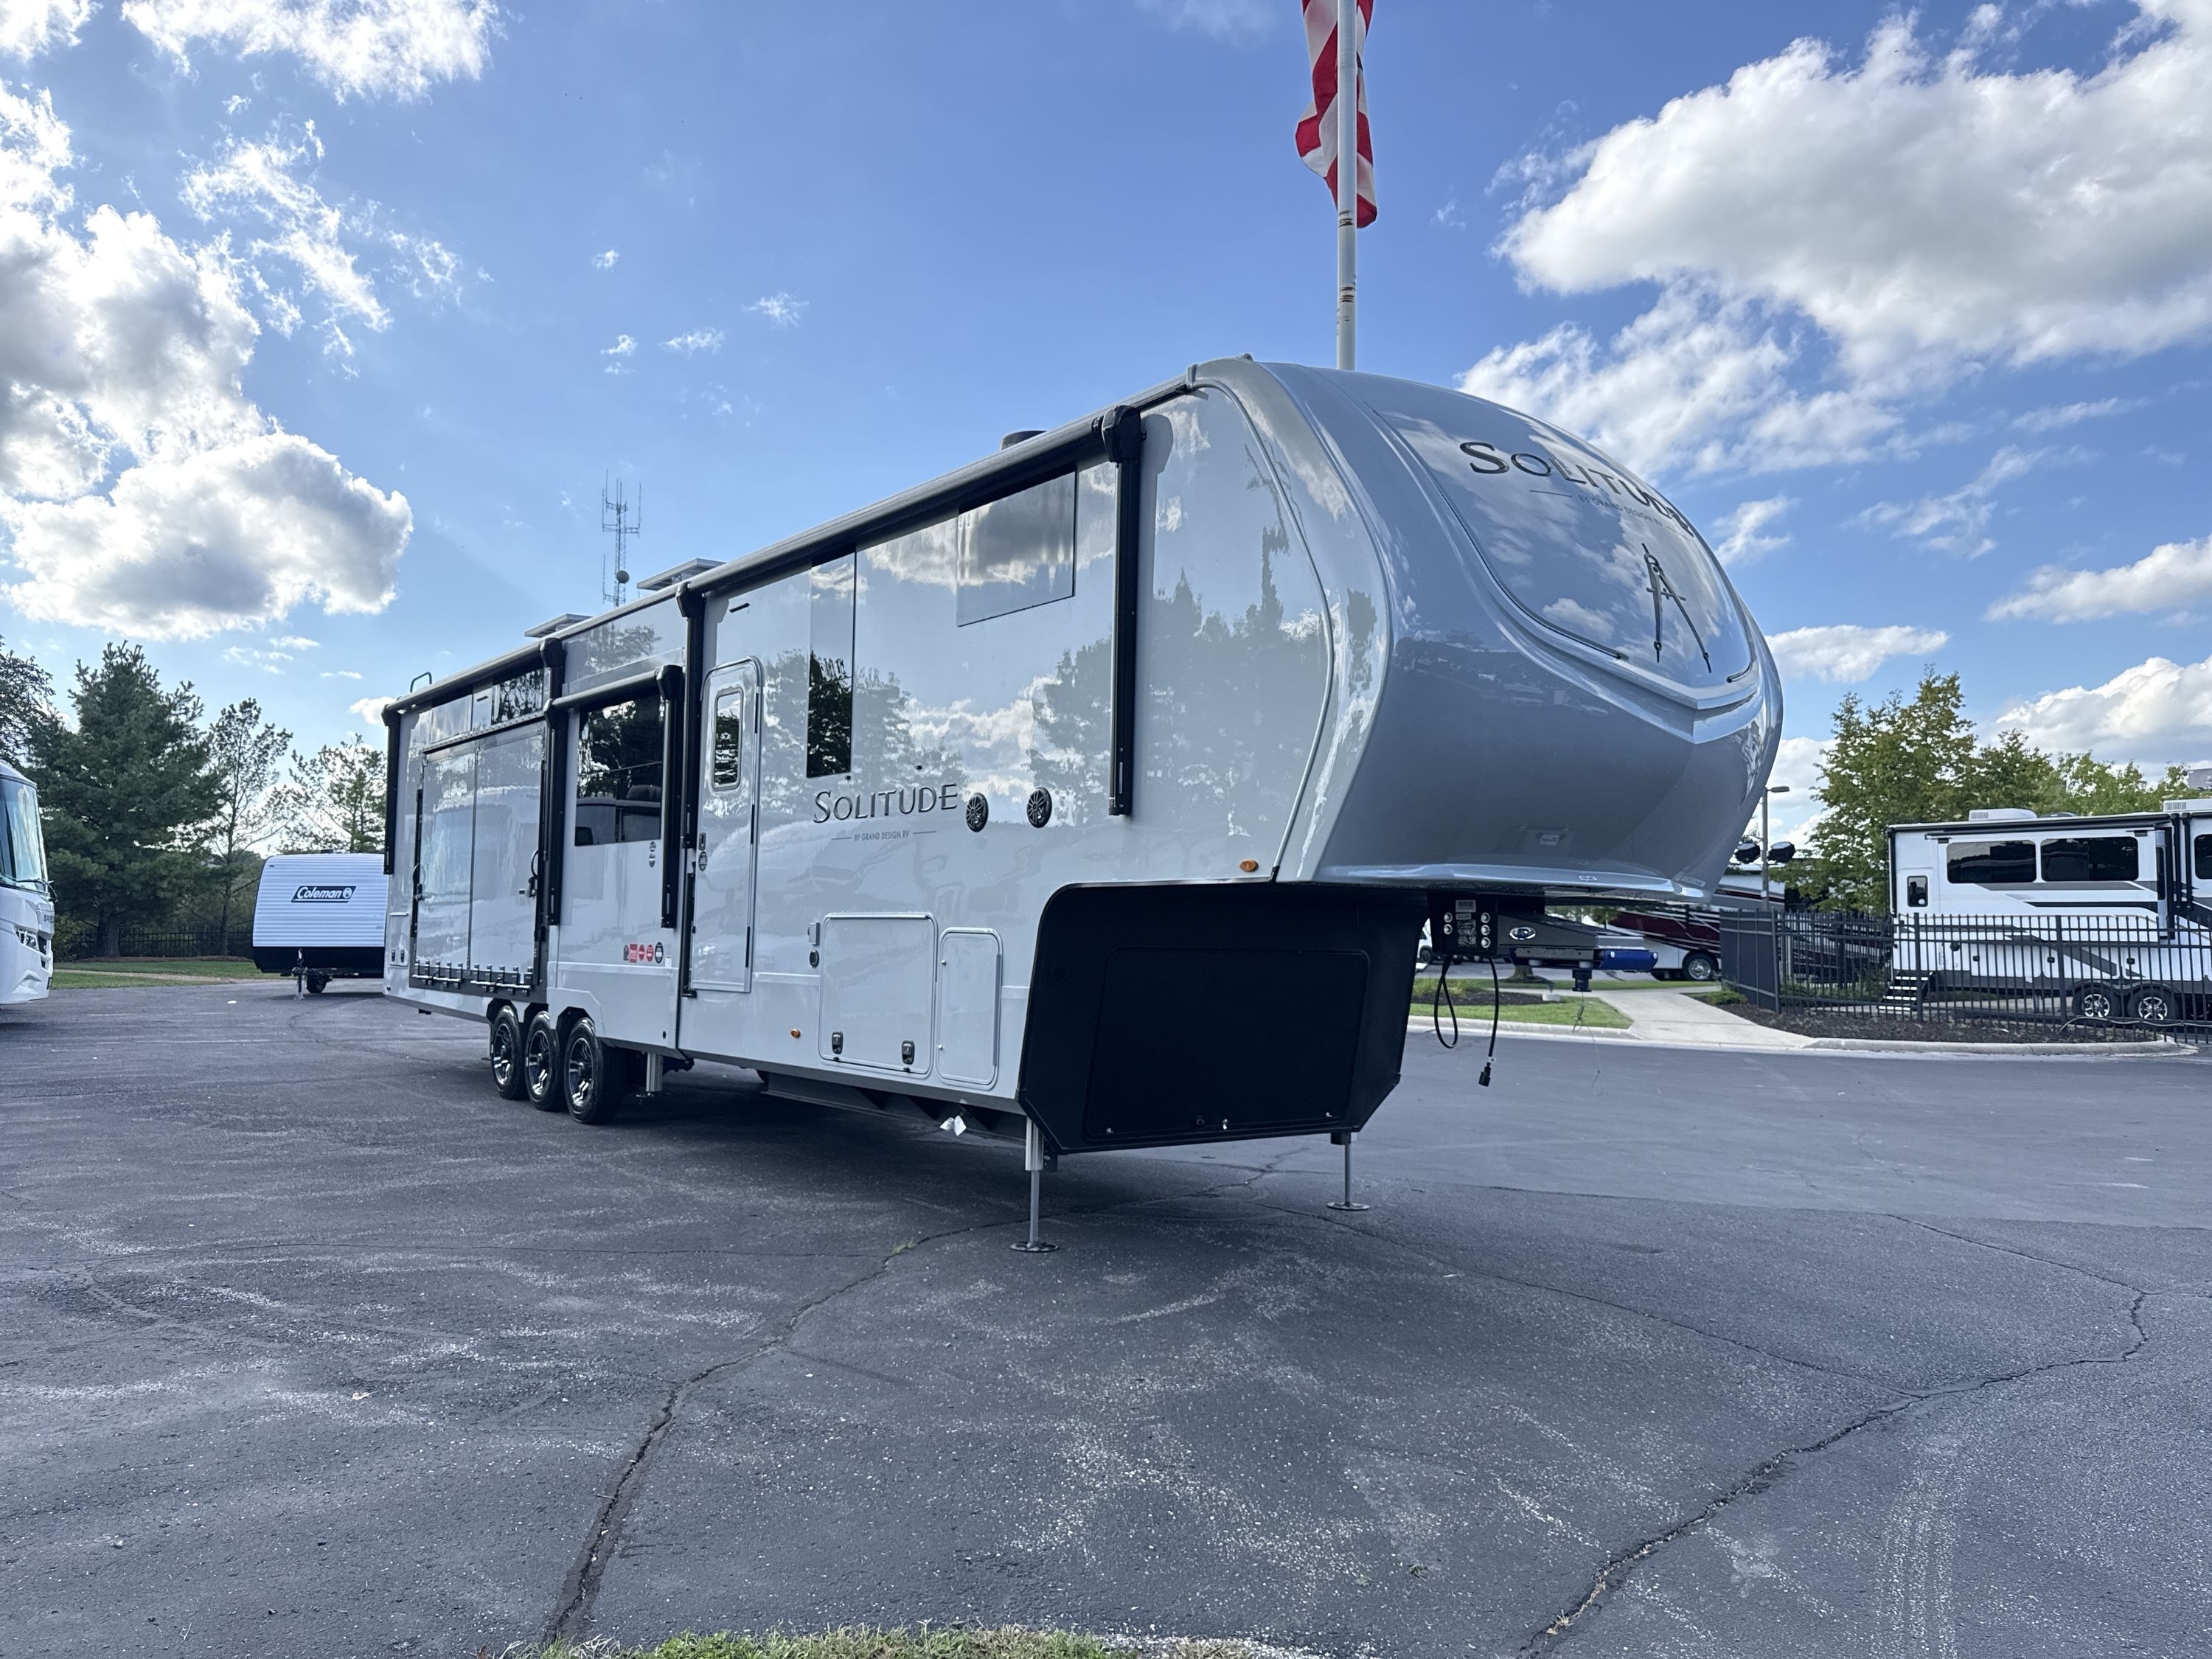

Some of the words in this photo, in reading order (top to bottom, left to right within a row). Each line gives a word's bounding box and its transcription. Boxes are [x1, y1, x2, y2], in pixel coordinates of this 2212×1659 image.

[813, 783, 958, 824] SOLITUDE
[854, 833, 860, 841] BY
[861, 832, 880, 841] GRAND
[881, 831, 901, 840] DESIGN
[902, 830, 910, 838] RV
[297, 886, 342, 899] Coleman
